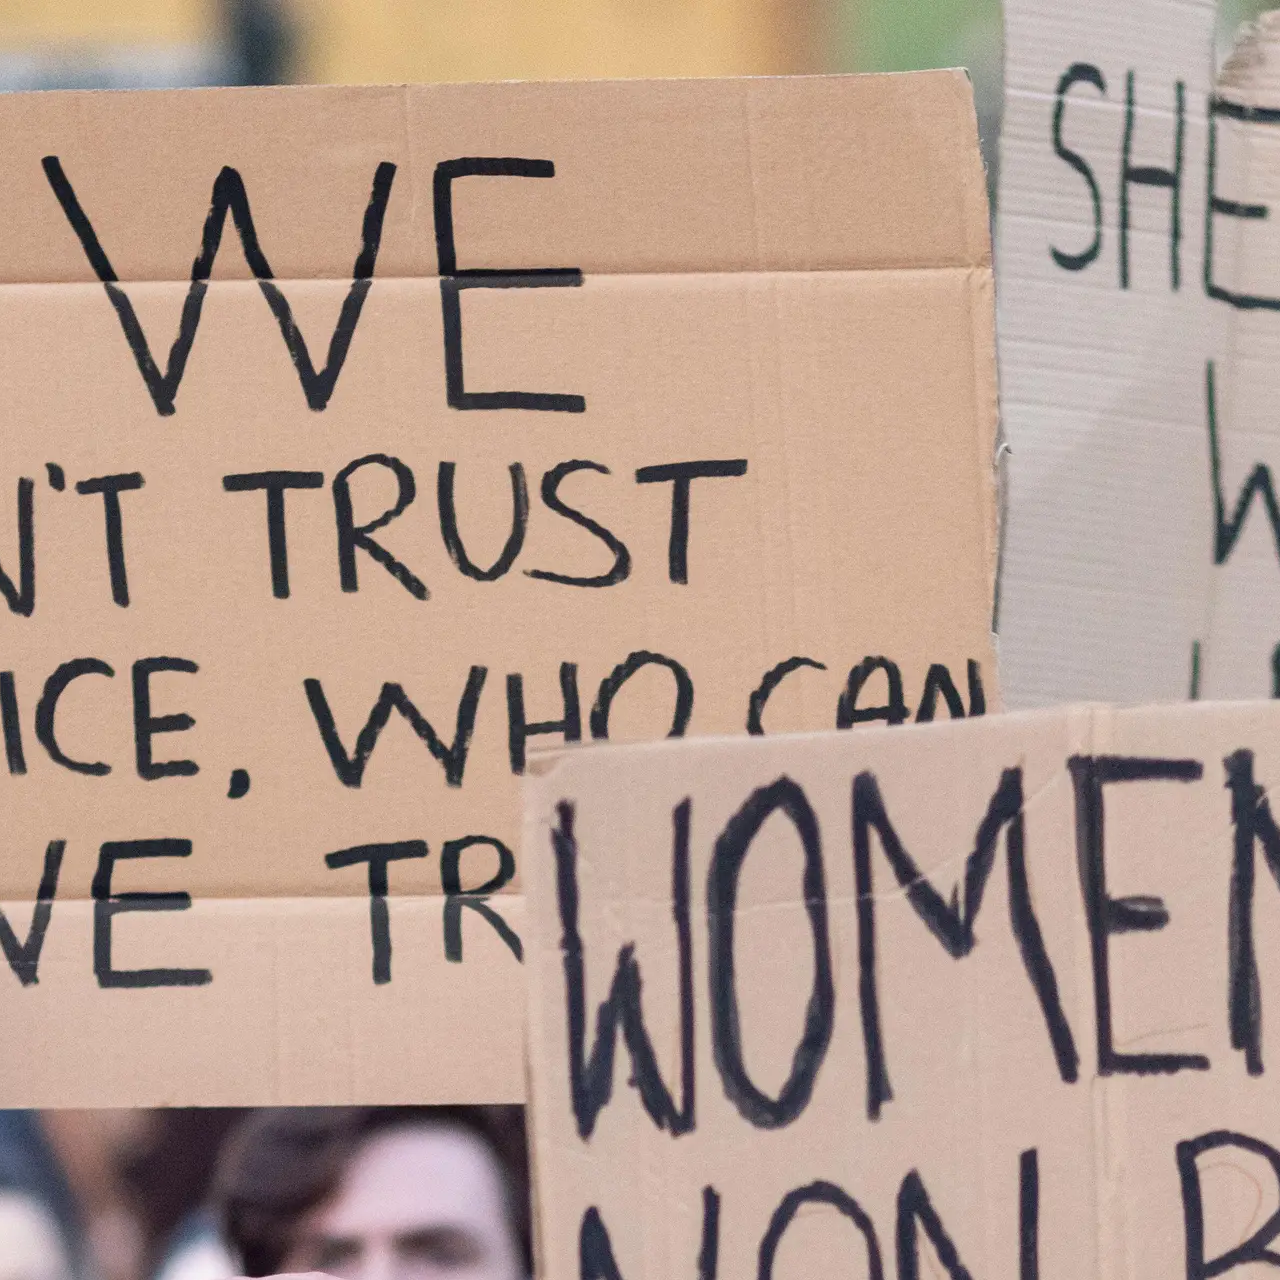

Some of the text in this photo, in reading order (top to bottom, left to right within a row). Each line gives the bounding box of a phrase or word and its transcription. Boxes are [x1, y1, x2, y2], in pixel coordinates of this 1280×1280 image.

[41, 155, 586, 417] WE
[223, 453, 749, 602] TRUST
[304, 650, 694, 788] WHO
